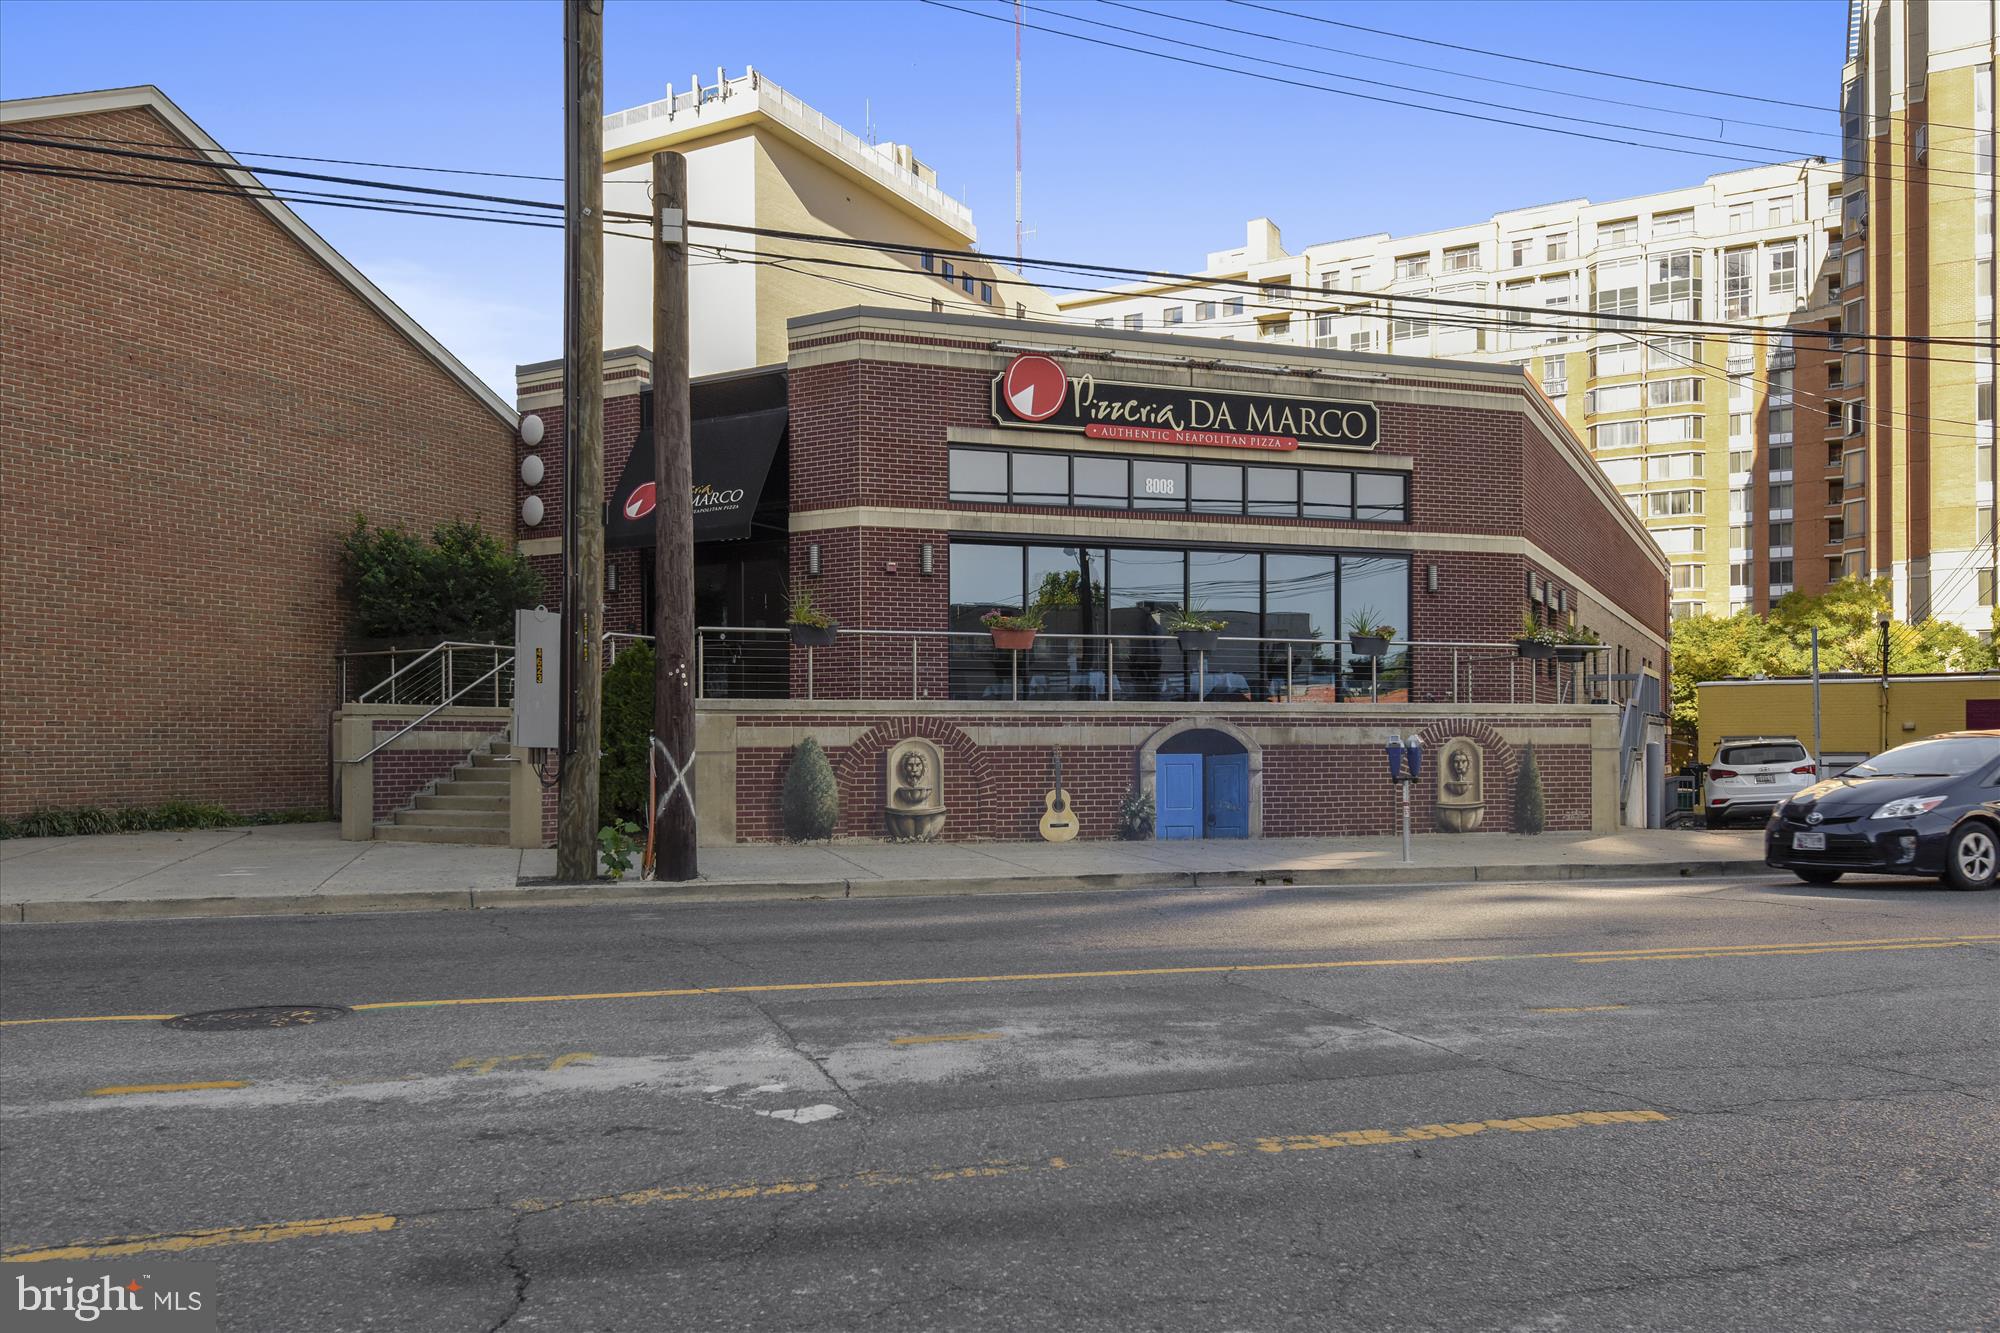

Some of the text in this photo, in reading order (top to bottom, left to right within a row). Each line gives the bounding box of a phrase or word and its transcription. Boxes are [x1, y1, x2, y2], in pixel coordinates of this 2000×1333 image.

[1072, 373, 1368, 439] Pizzeria DA MARCO
[1101, 427, 1281, 448] AUTHENTIC NEAPOLITAN PIZZA
[1145, 478, 1174, 494] 8008
